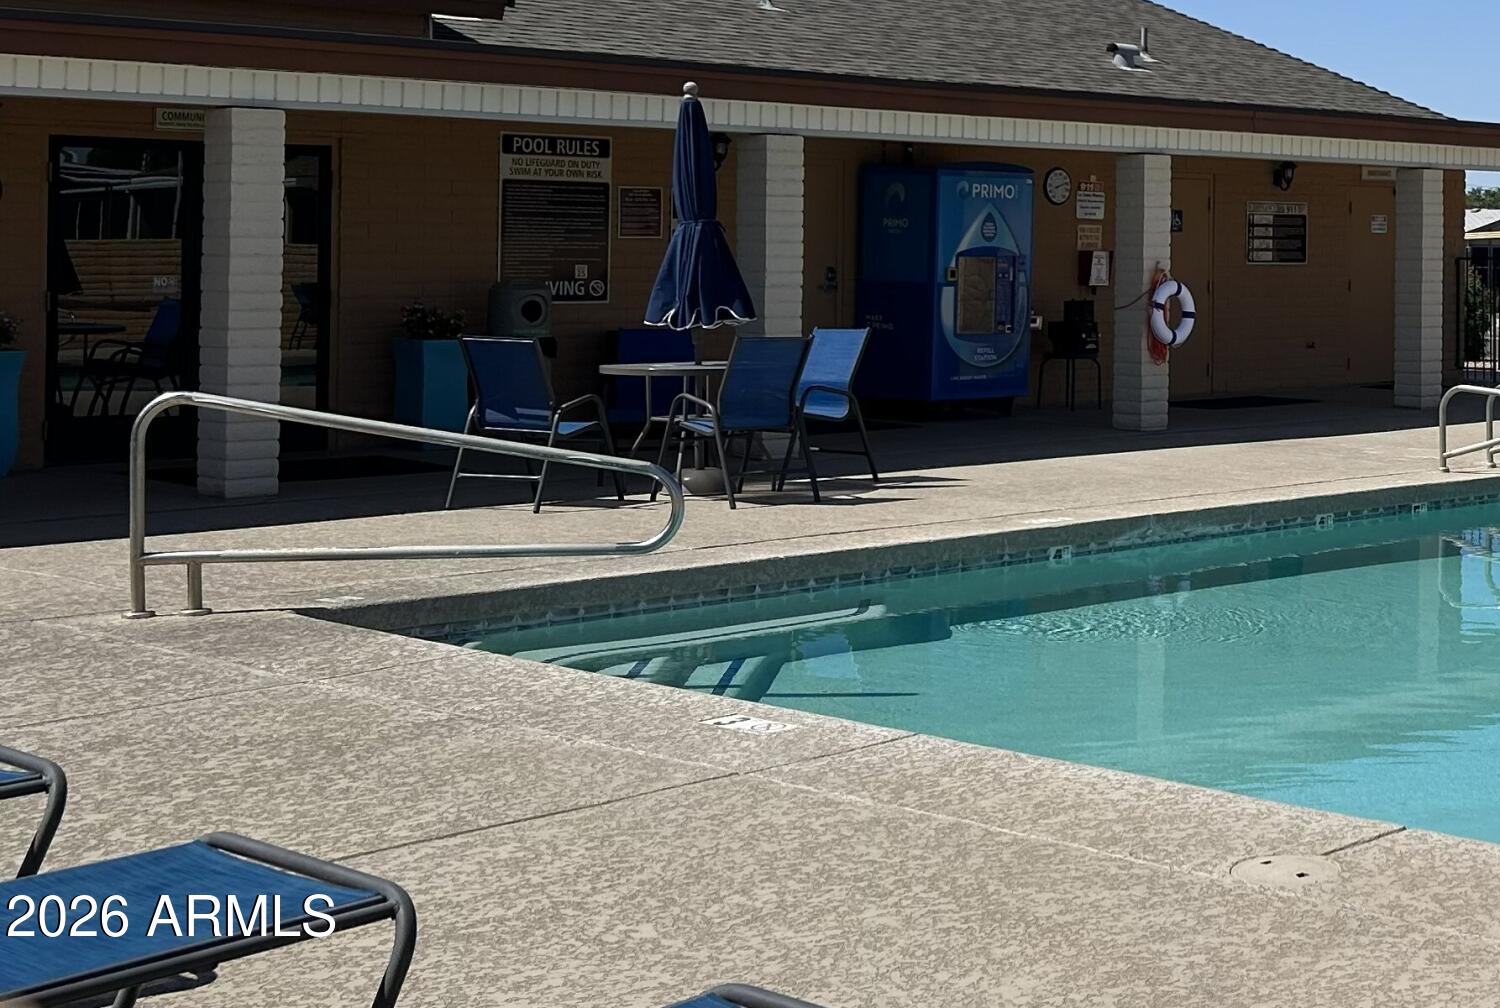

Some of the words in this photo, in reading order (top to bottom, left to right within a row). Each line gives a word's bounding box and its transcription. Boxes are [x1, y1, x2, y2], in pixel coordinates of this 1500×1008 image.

[512, 137, 553, 153] POOL
[556, 139, 600, 156] RULES
[511, 158, 523, 166] NO
[525, 159, 565, 168] LIFEGUARD
[567, 160, 580, 168] ON
[581, 160, 600, 169] DUTY
[509, 168, 531, 176] SWIM
[533, 168, 543, 176] AT
[544, 168, 565, 177] YOUR
[566, 169, 584, 178] OWN
[586, 170, 602, 178] RISK
[972, 183, 1015, 199] PRIMO
[545, 280, 585, 296] VING
